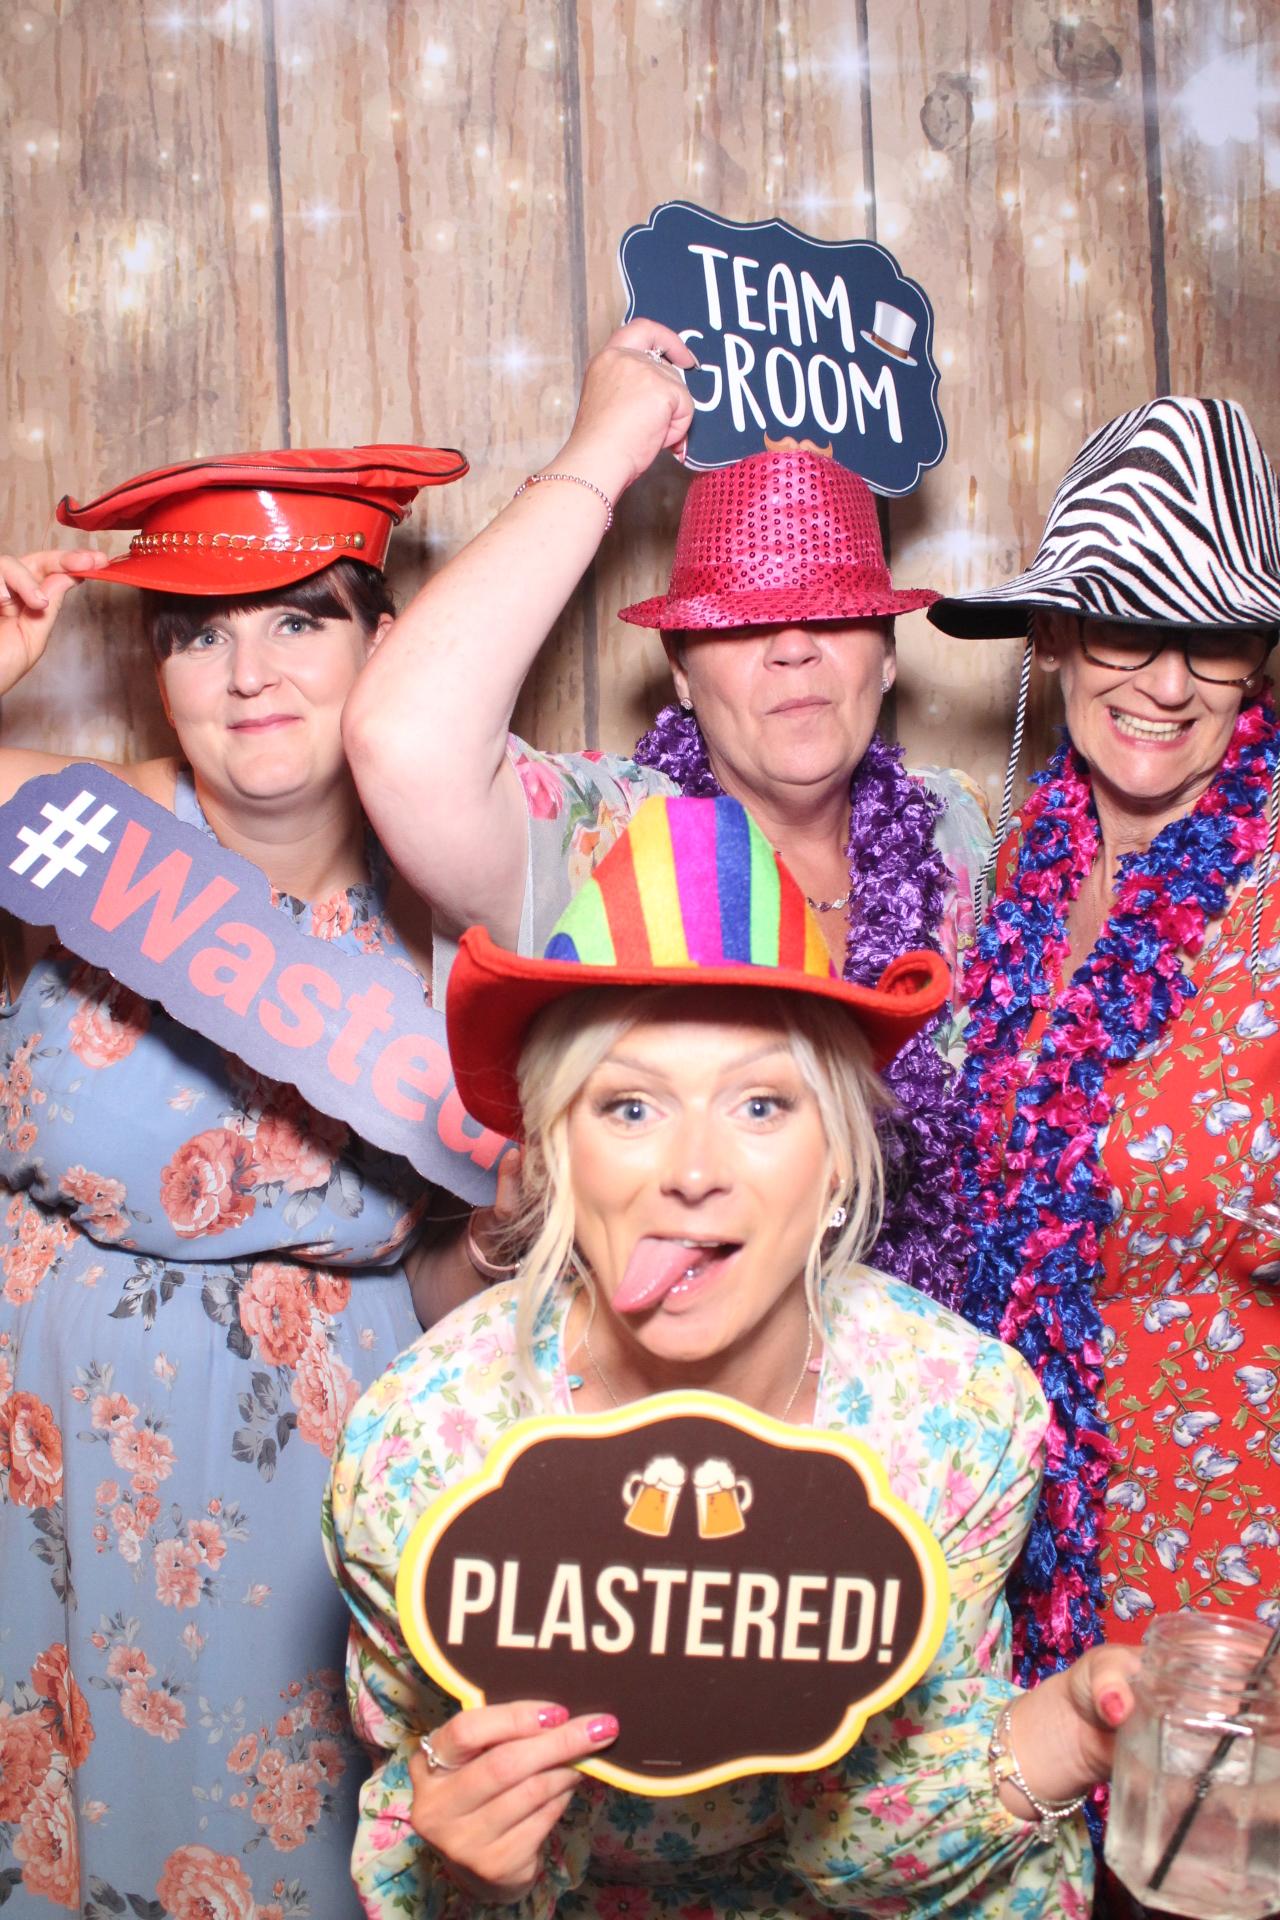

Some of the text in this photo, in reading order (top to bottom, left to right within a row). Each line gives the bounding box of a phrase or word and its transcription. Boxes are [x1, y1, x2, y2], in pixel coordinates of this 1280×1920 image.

[688, 244, 856, 353] TEAM
[678, 329, 903, 443] GROOM
[447, 1557, 901, 1663] PLASTERED!
